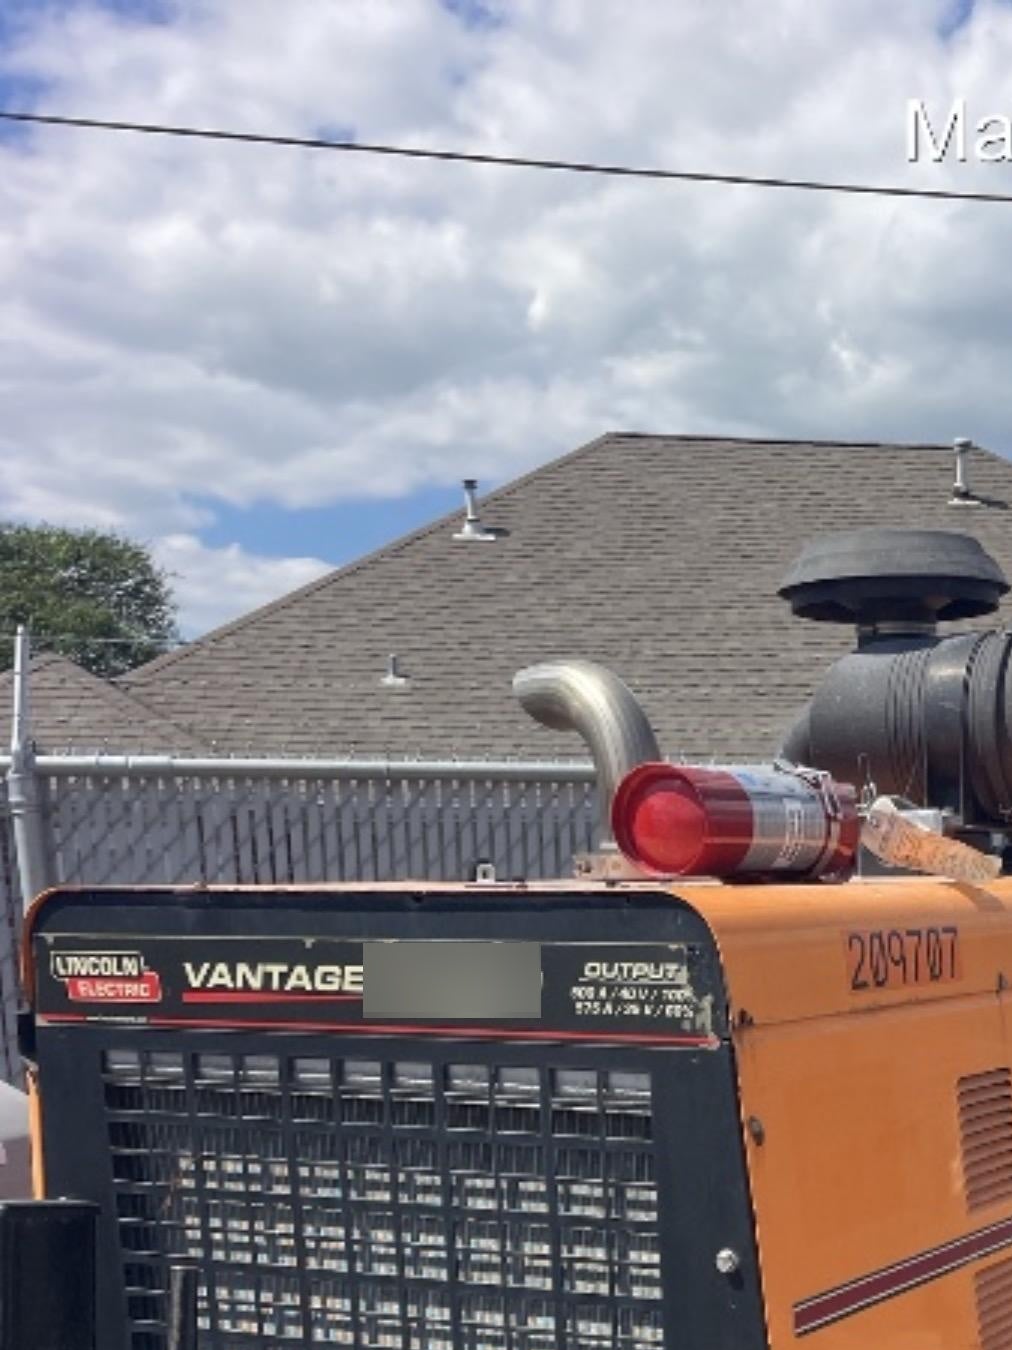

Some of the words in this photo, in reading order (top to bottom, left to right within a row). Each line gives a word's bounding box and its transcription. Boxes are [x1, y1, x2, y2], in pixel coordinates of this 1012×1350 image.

[56, 956, 139, 976] LINCOLN
[847, 927, 957, 991] 209707
[184, 961, 363, 992] VANTAGE
[584, 961, 680, 979] OUTPUT
[77, 980, 151, 998] ELECTRIC
